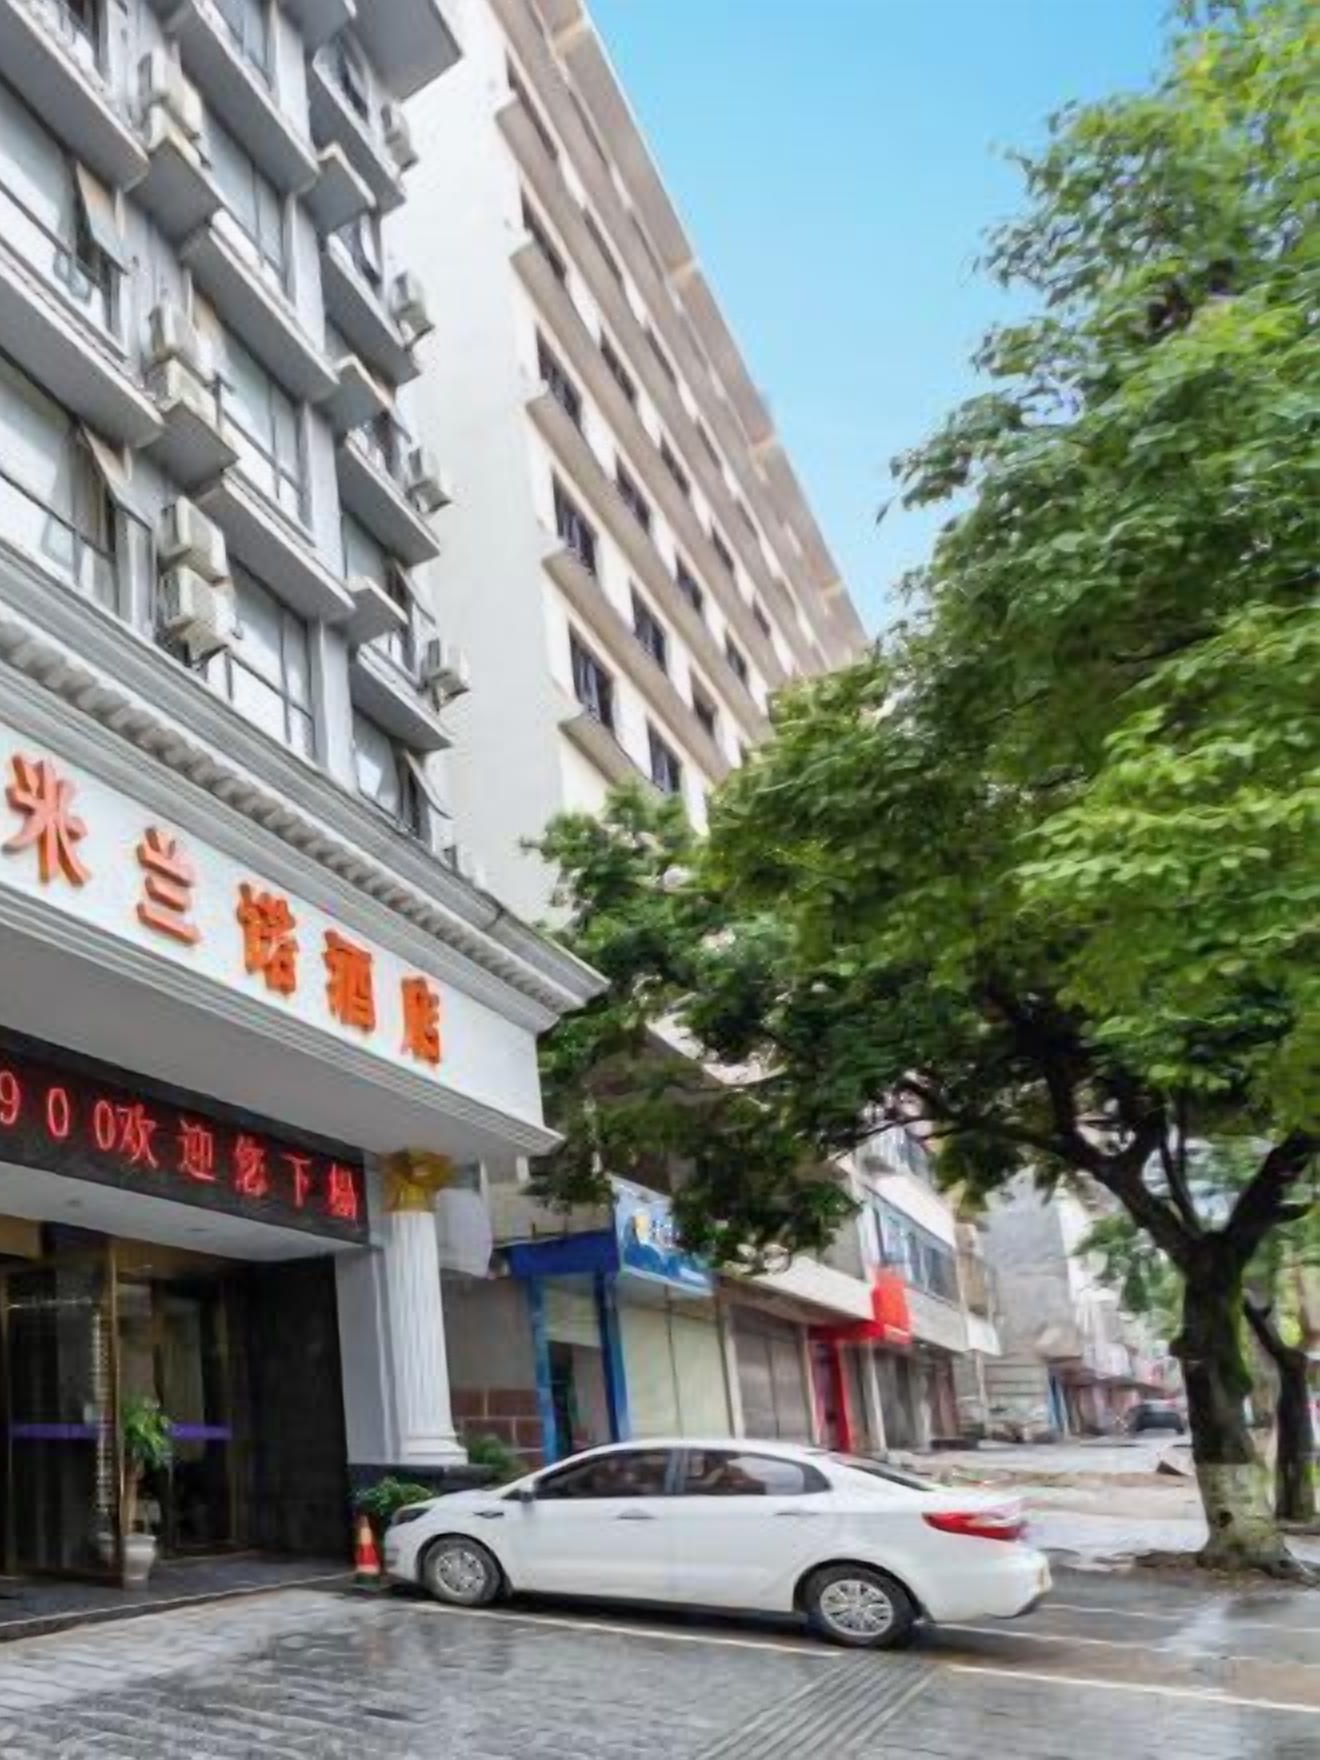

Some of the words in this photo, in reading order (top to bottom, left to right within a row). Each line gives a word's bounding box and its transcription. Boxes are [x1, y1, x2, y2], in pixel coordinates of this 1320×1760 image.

[1, 753, 441, 1065] 米兰诺酒店
